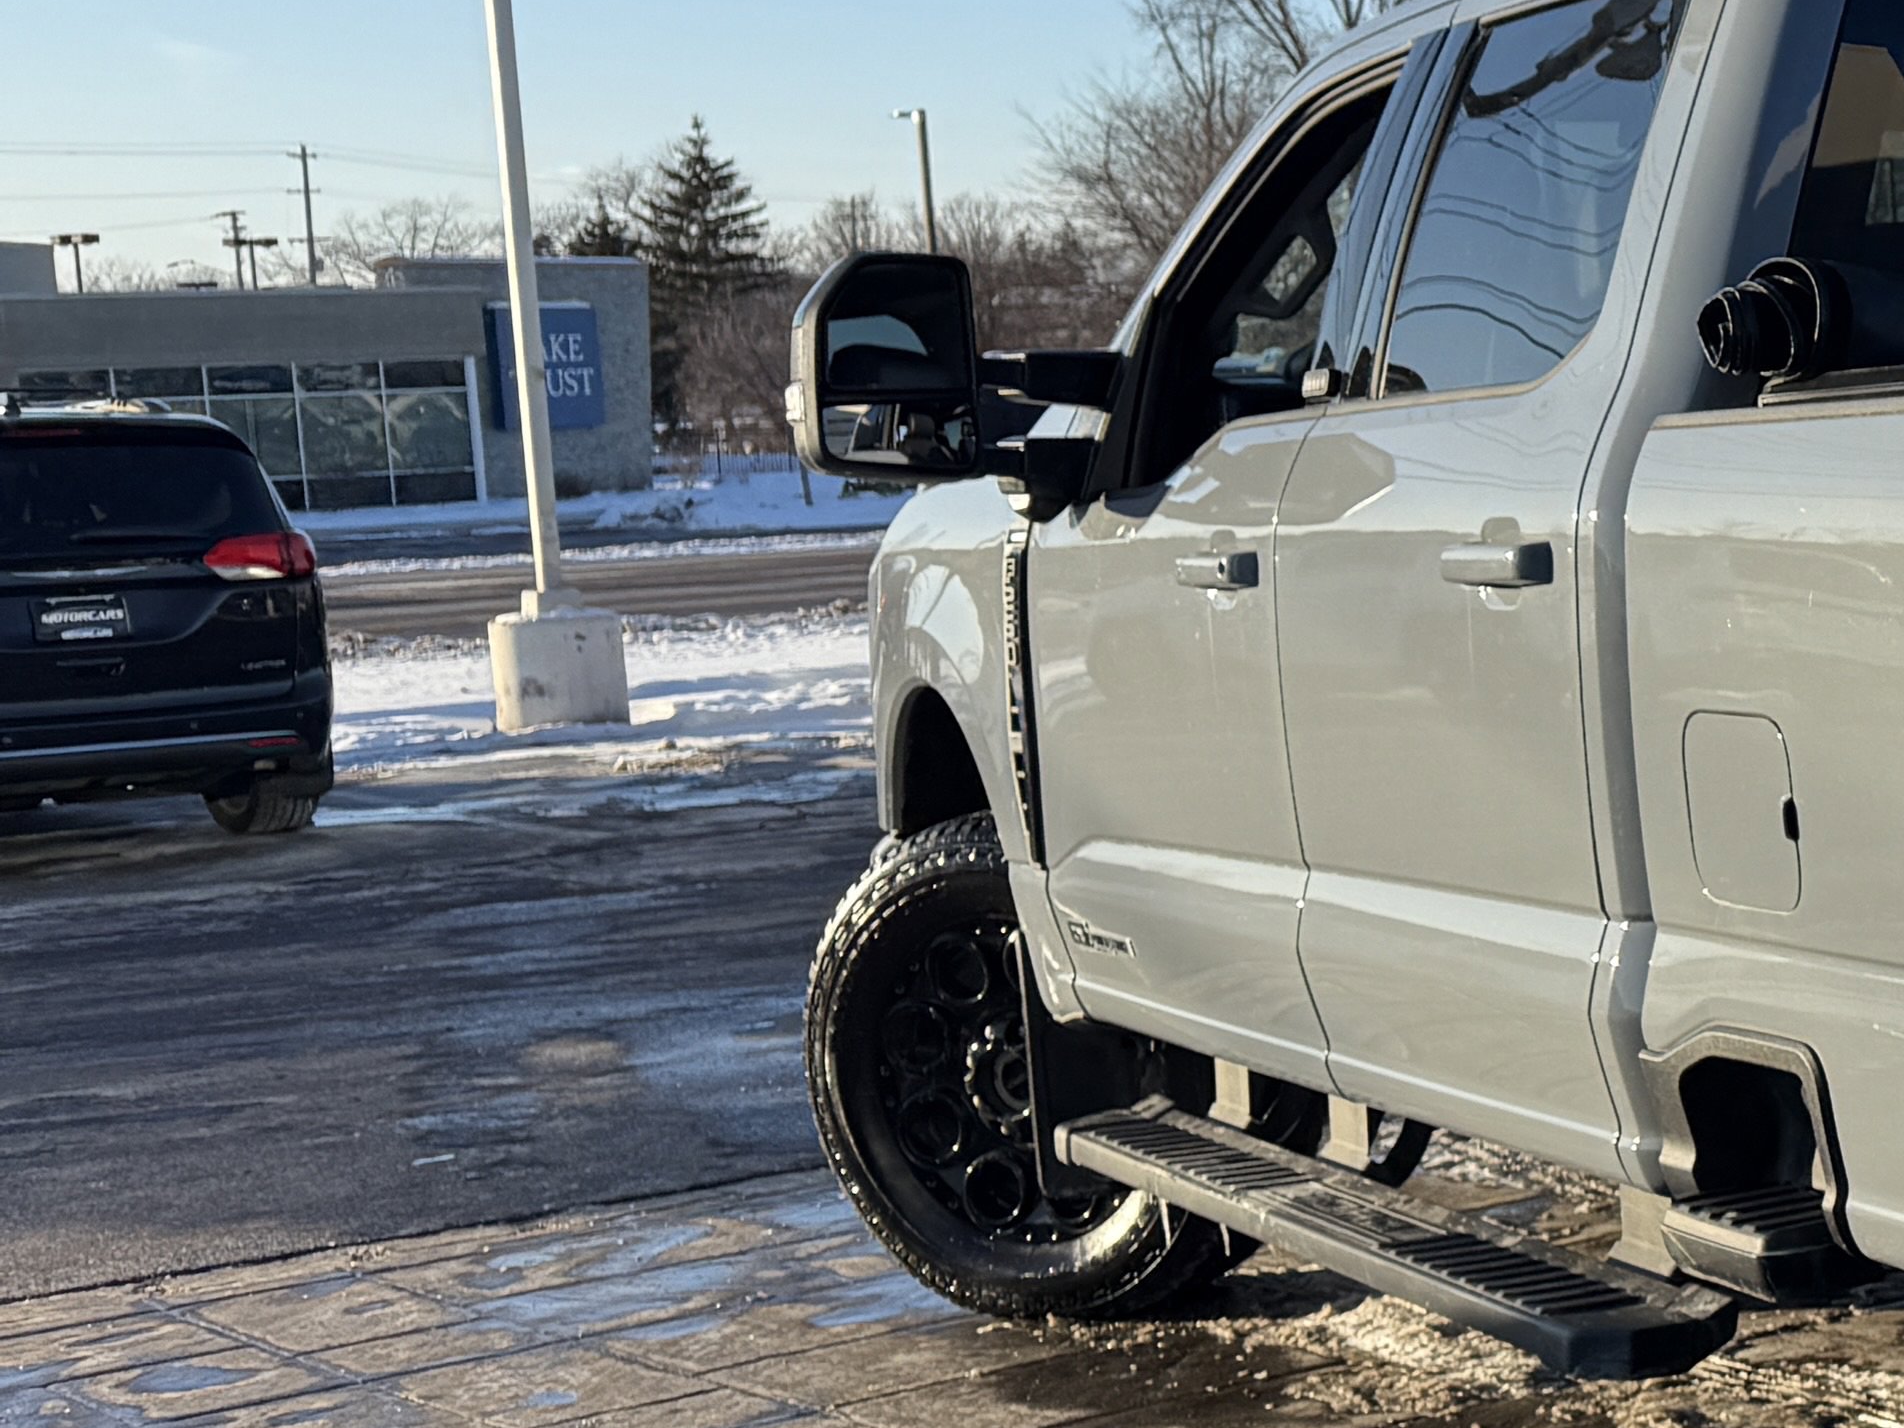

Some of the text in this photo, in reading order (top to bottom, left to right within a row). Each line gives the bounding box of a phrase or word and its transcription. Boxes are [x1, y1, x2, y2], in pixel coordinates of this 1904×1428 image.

[541, 333, 584, 362] KE
[509, 367, 594, 398] UST
[41, 609, 124, 624] MOTORCARS
